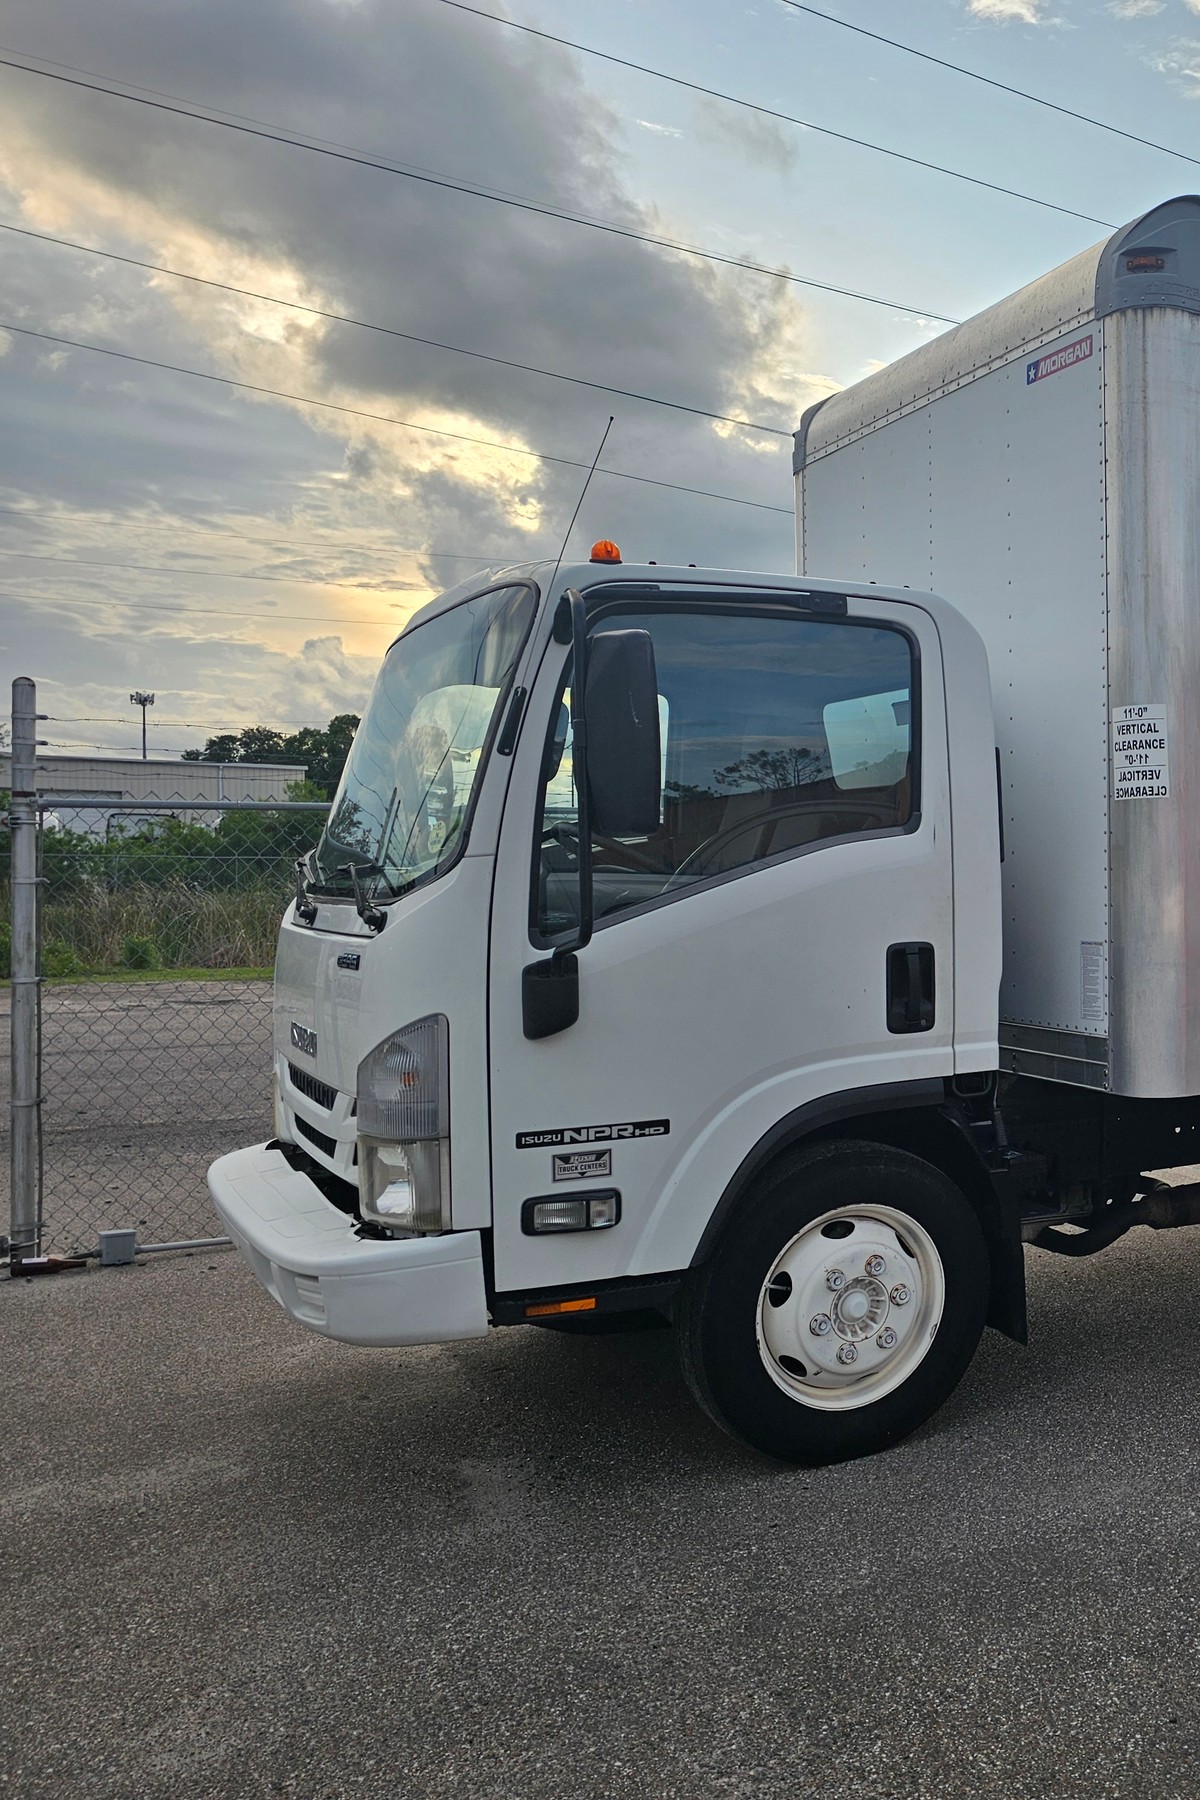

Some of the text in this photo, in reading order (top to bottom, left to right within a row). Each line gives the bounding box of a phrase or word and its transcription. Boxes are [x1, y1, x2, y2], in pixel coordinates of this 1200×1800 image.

[1038, 339, 1092, 377] MORGAN
[1116, 722, 1159, 735] VERTICAL
[1114, 738, 1165, 752] CLEARANCE
[521, 1133, 561, 1145] ISUZU
[563, 1124, 634, 1143] NPR
[558, 1161, 607, 1174] TRUCK CENTERS
